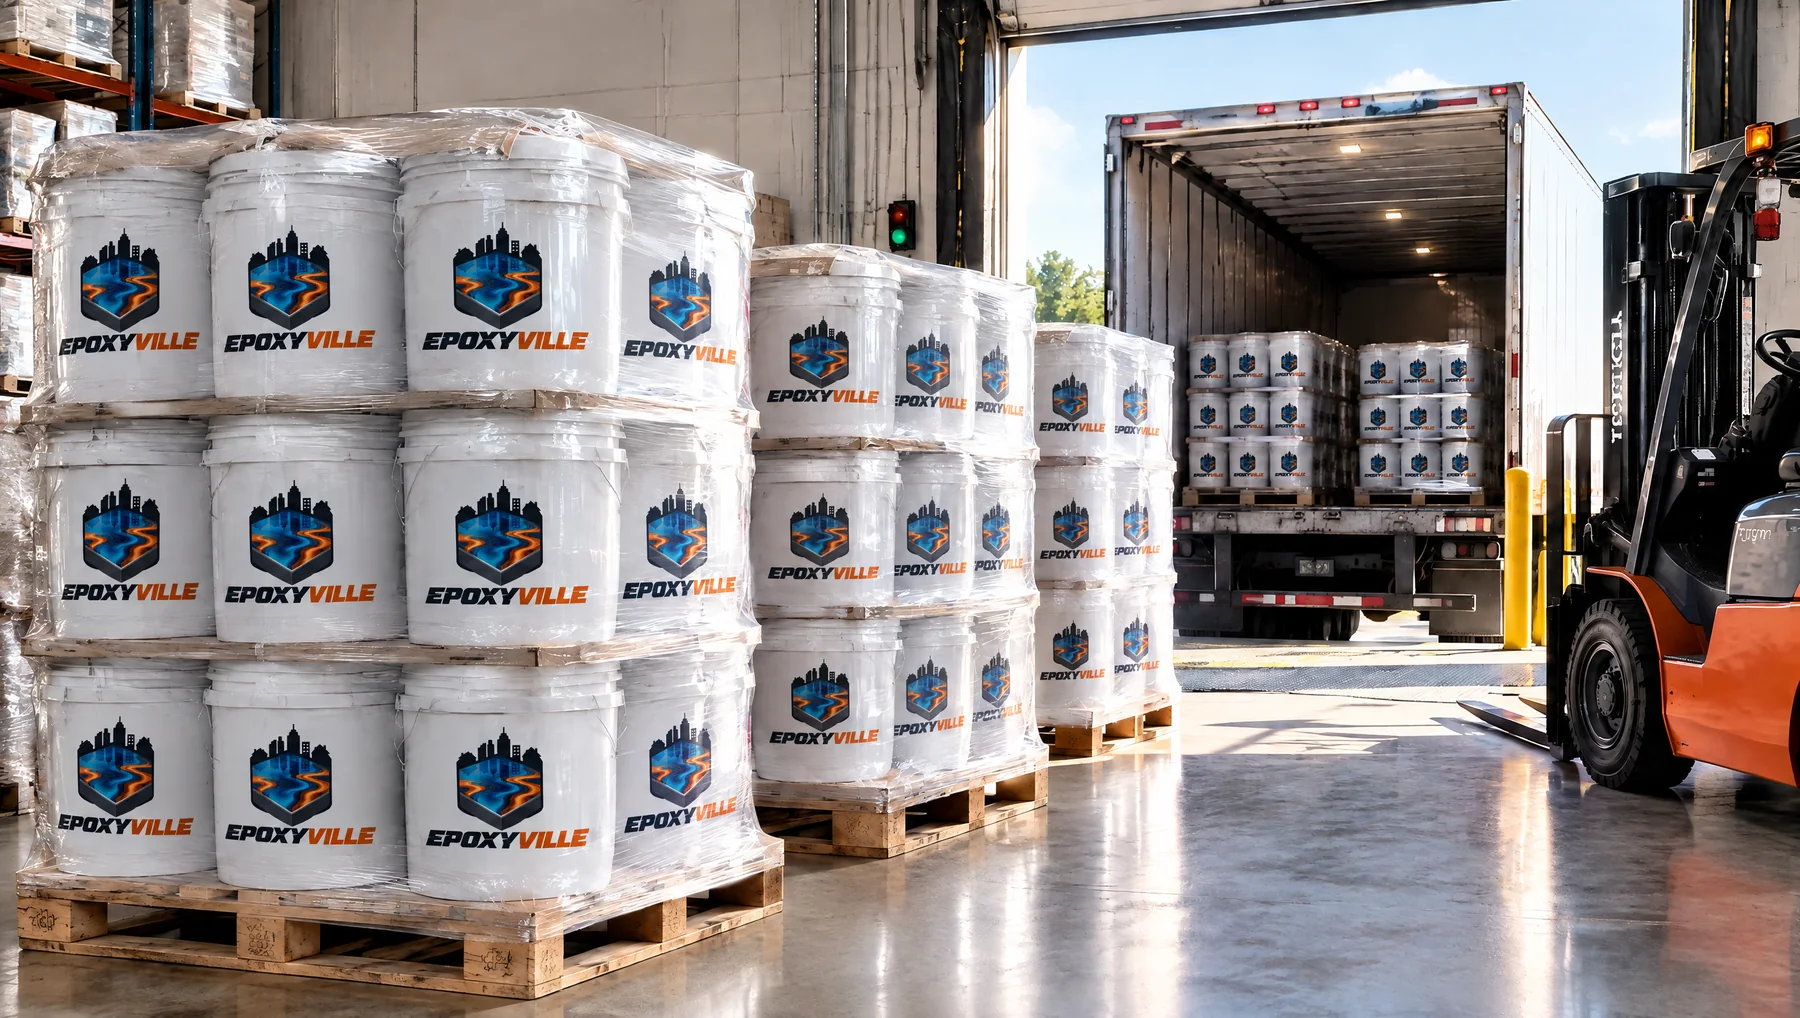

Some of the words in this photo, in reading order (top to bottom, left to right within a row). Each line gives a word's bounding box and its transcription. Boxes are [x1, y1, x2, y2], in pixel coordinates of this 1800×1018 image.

[59, 331, 200, 356] EPOXYVILLE
[224, 329, 376, 353] EPOXYVILLE
[422, 332, 589, 351] EPOXYVILLE
[624, 340, 737, 365] EPOXYVILLE
[767, 390, 879, 404] EPOXYVILLE
[894, 394, 967, 411] EPOXYVILLE
[974, 401, 1024, 417] POXYVILLE
[1039, 421, 1105, 433] EPOXYVILLE
[1040, 548, 1106, 560] EPOXYVILLE
[768, 566, 879, 581] EPOXYVILLE
[894, 561, 967, 577] EPOXYVILLE
[974, 558, 1024, 572] POXYVILLE
[62, 582, 199, 601] EPOXYVILLE
[225, 583, 377, 604] EPOXYVILLE
[425, 585, 589, 605] EPOXYVILLE
[623, 576, 736, 599] EPOXYVILLE
[1040, 668, 1105, 681] EPOXYVILLE
[894, 715, 965, 737] EPOXYVILLE
[769, 729, 879, 745] EPOXYVILLE
[58, 813, 194, 836] EPOXYVILLE
[624, 796, 737, 834] EPOXYVILLE
[225, 824, 376, 845] EPOXYVILLE
[426, 828, 590, 849] EPOXYVILLE
